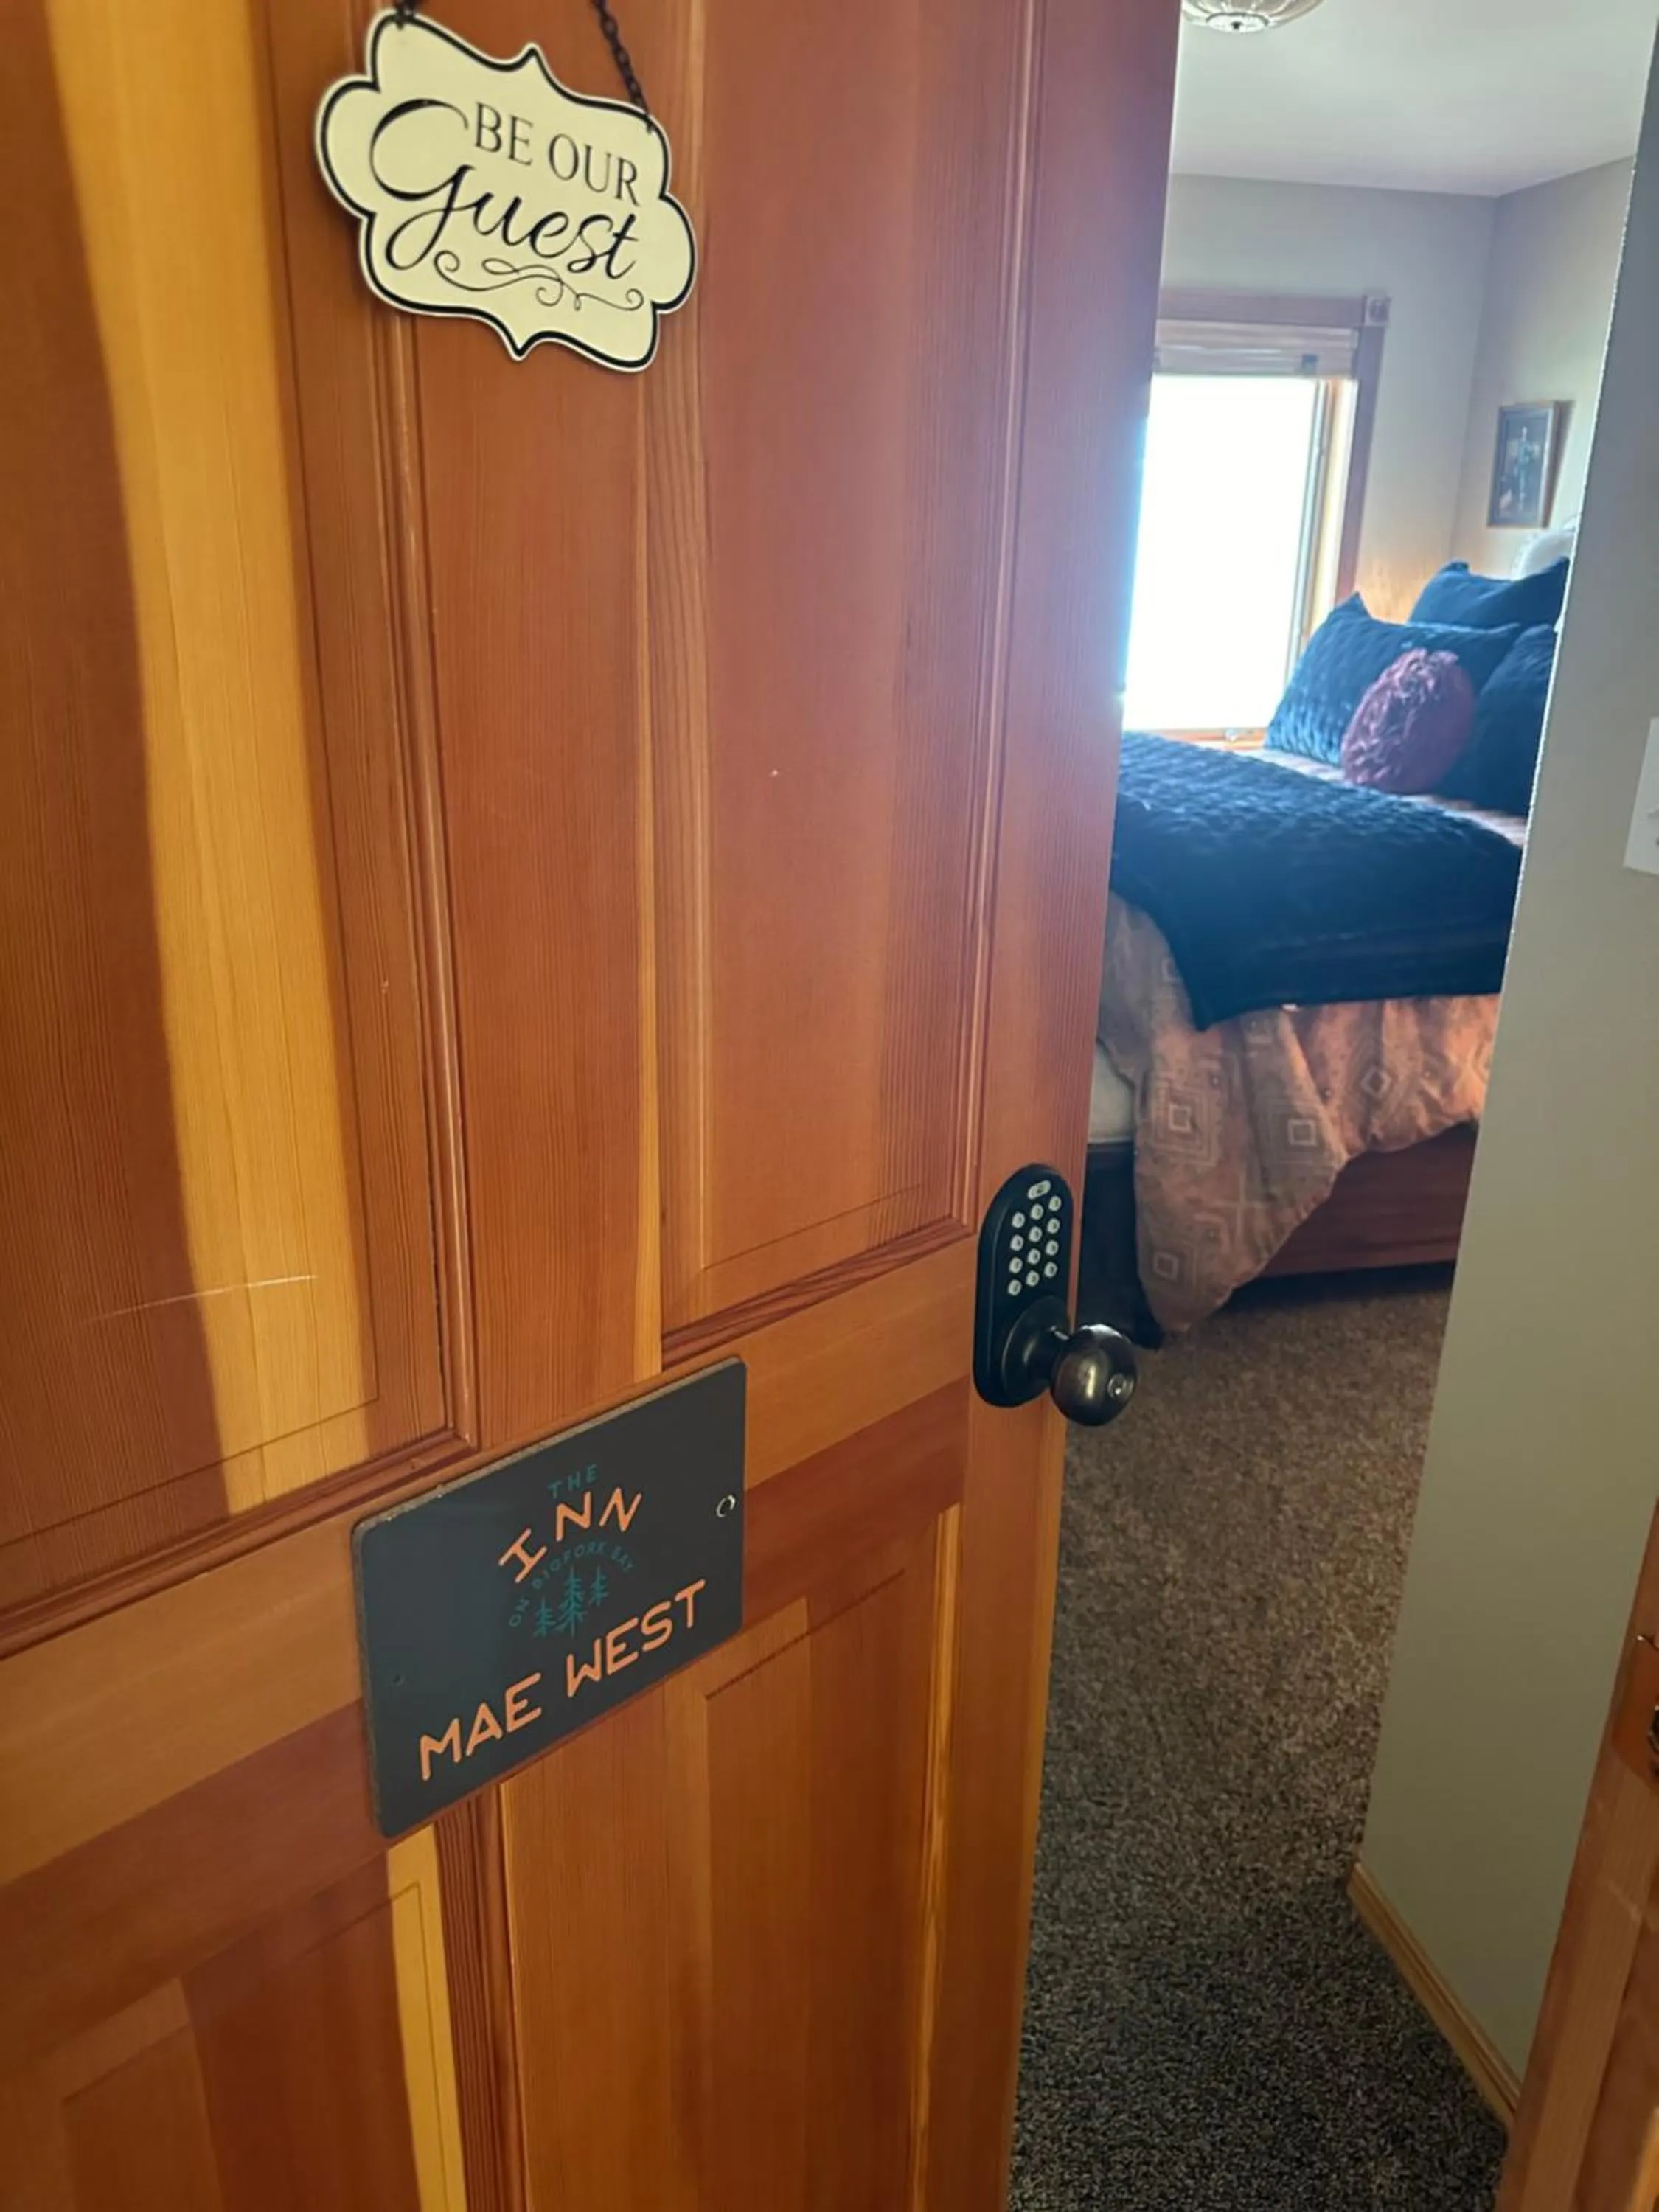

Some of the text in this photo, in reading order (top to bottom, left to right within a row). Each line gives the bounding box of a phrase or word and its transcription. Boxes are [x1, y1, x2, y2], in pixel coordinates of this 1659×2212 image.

[474, 102, 641, 206] BE OUR
[548, 1464, 597, 1499] THE
[498, 1486, 642, 1583] INN
[508, 1540, 635, 1627] ON BIGFORK BAY
[420, 1579, 706, 1781] MAE WEST
